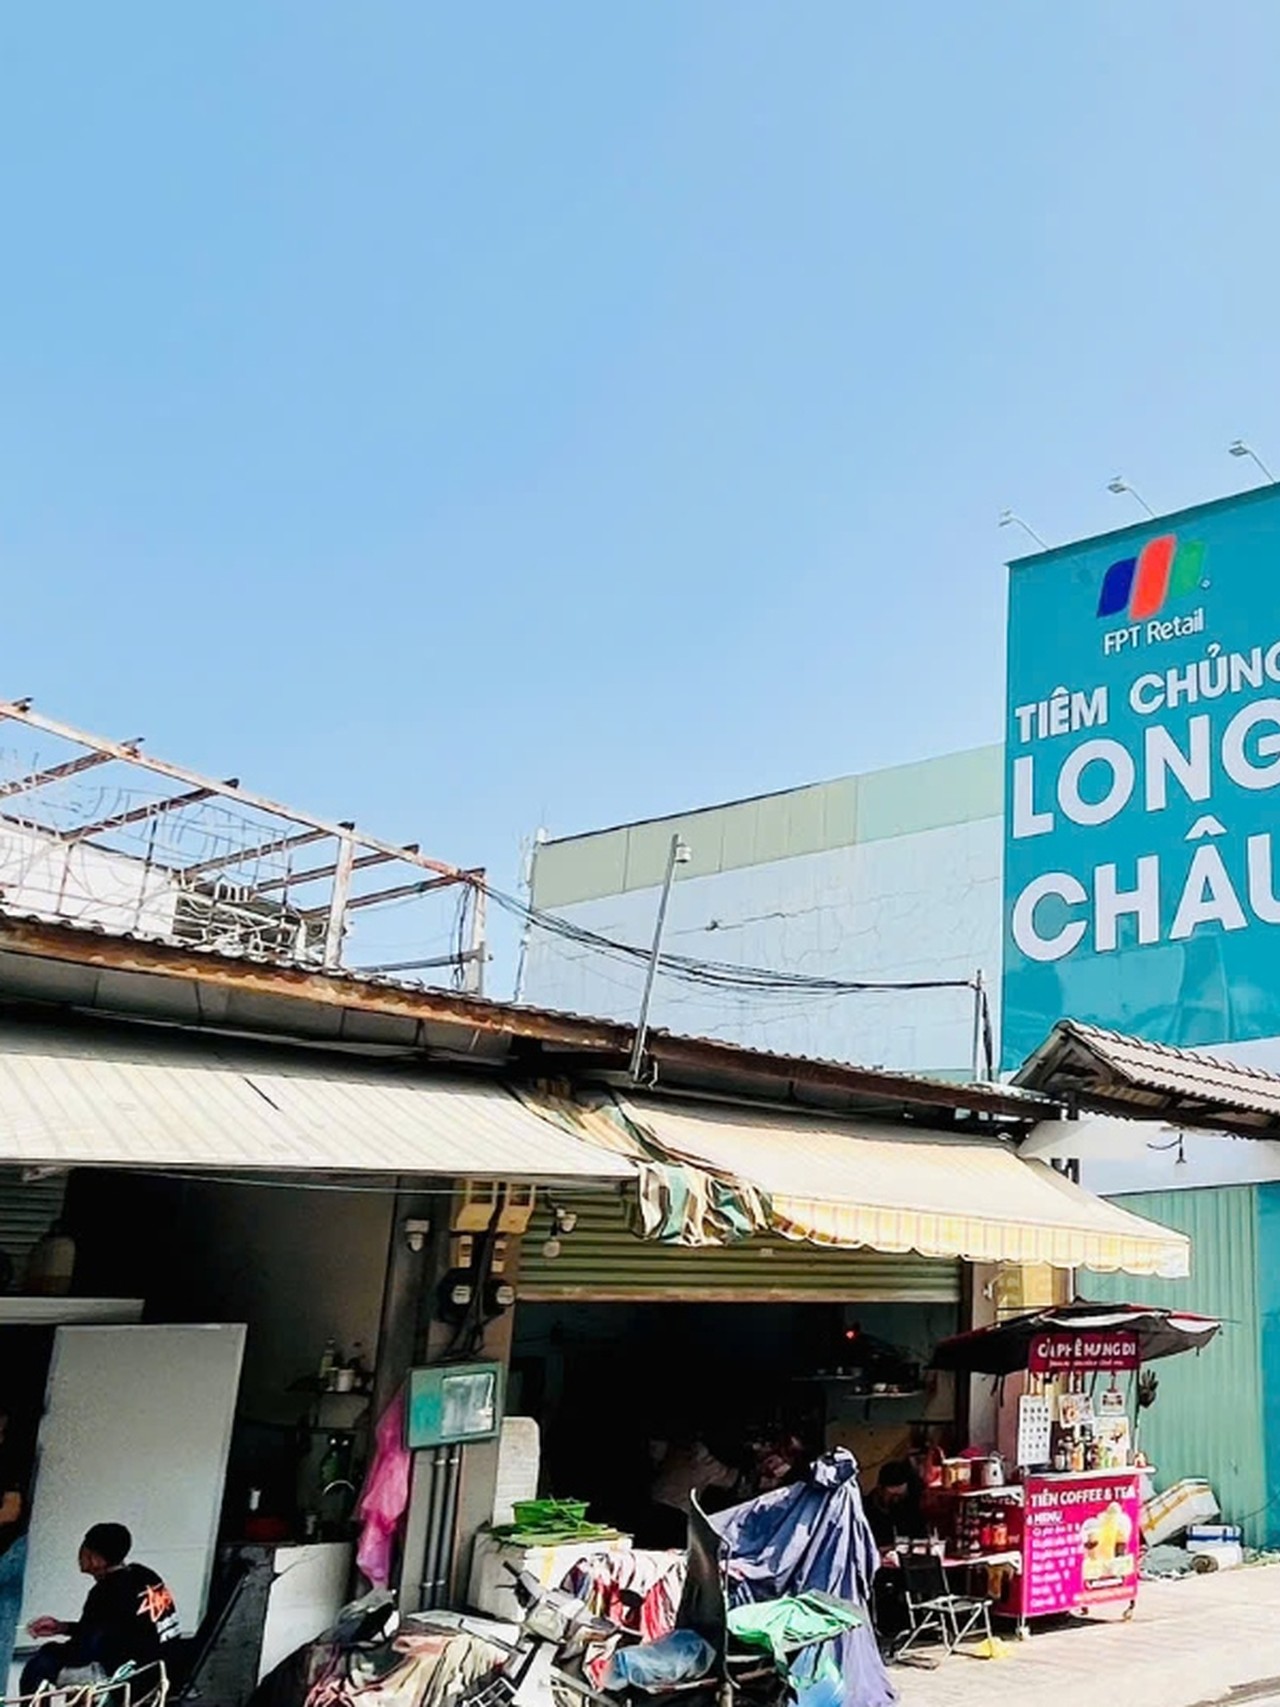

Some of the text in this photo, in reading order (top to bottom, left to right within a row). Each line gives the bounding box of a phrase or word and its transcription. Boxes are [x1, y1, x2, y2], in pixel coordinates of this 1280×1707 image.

[1104, 607, 1204, 655] FPT Retail
[1015, 686, 1108, 744] TIÊM
[1060, 1489, 1103, 1505] COFFEE
[1114, 1485, 1136, 1499] TEA
